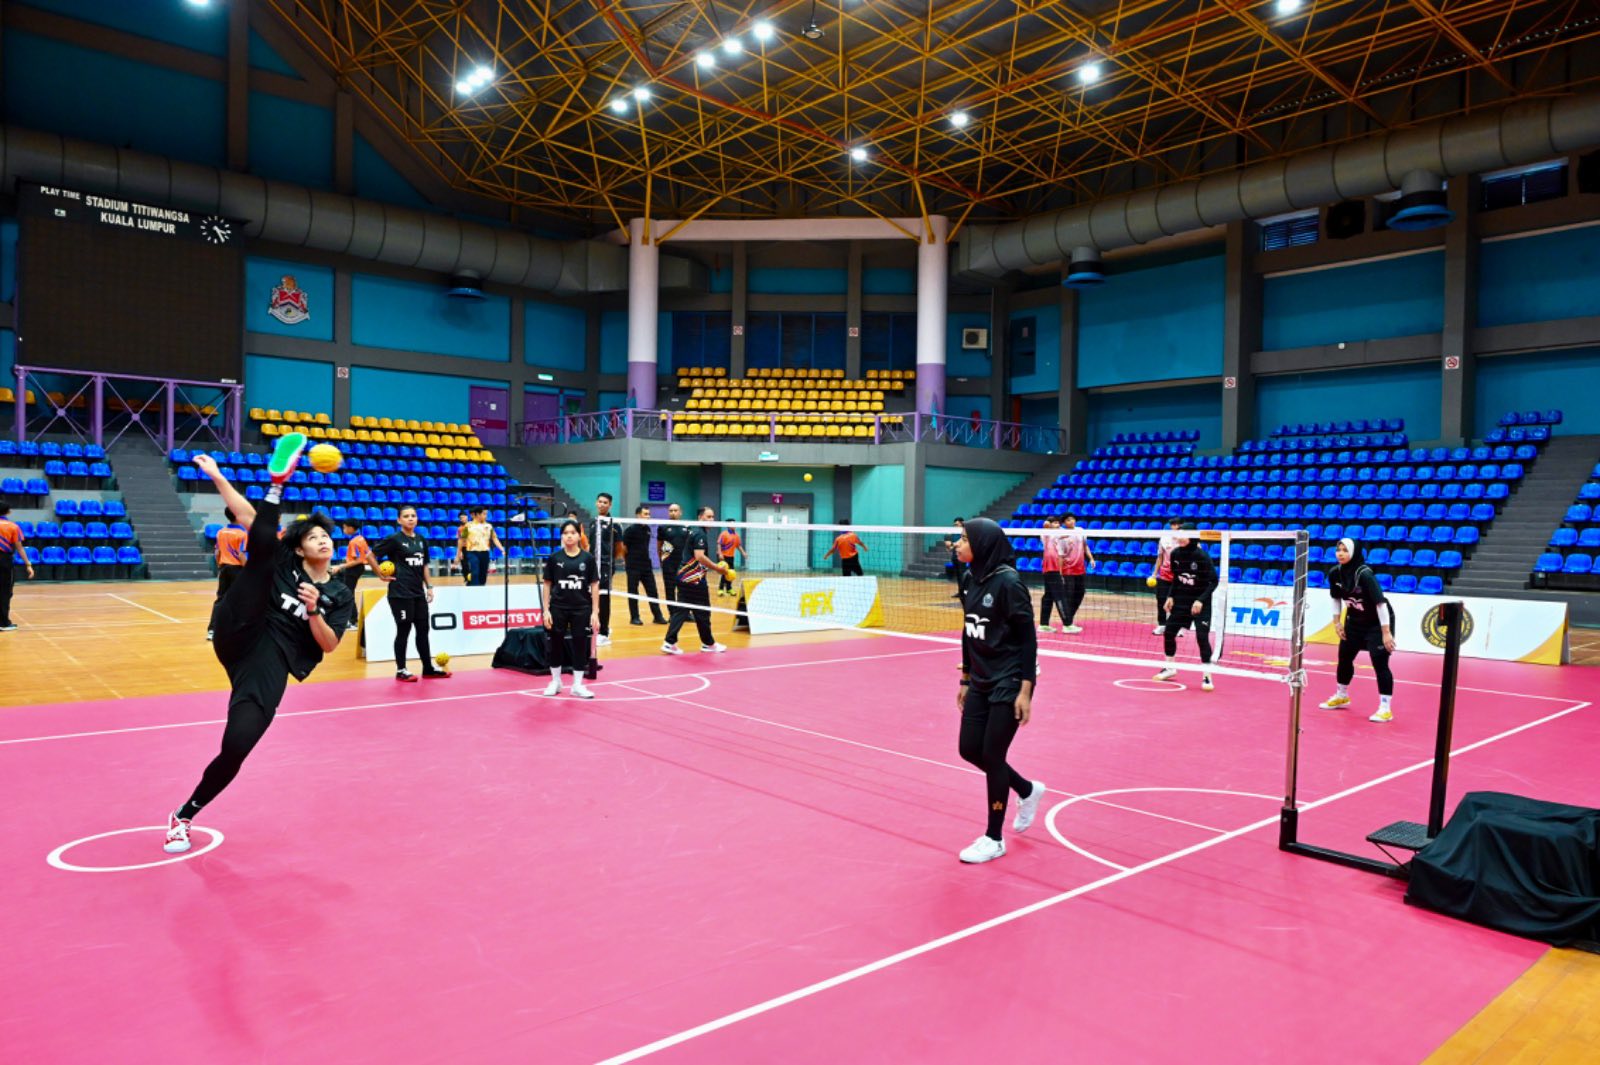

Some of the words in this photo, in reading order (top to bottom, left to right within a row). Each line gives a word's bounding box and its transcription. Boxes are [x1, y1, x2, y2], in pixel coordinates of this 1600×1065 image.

[40, 186, 60, 196] PLAY
[62, 190, 81, 200] TIME
[85, 195, 129, 213] STADIUM
[131, 202, 190, 224] TITIWANGSA
[100, 211, 135, 228] KUALA
[137, 218, 176, 234] LUMPUR
[405, 557, 424, 566] TM
[558, 579, 582, 590] TM
[400, 609, 407, 620] 3
[525, 612, 542, 623] TV
[1231, 606, 1281, 627] TM
[964, 621, 986, 641] M
